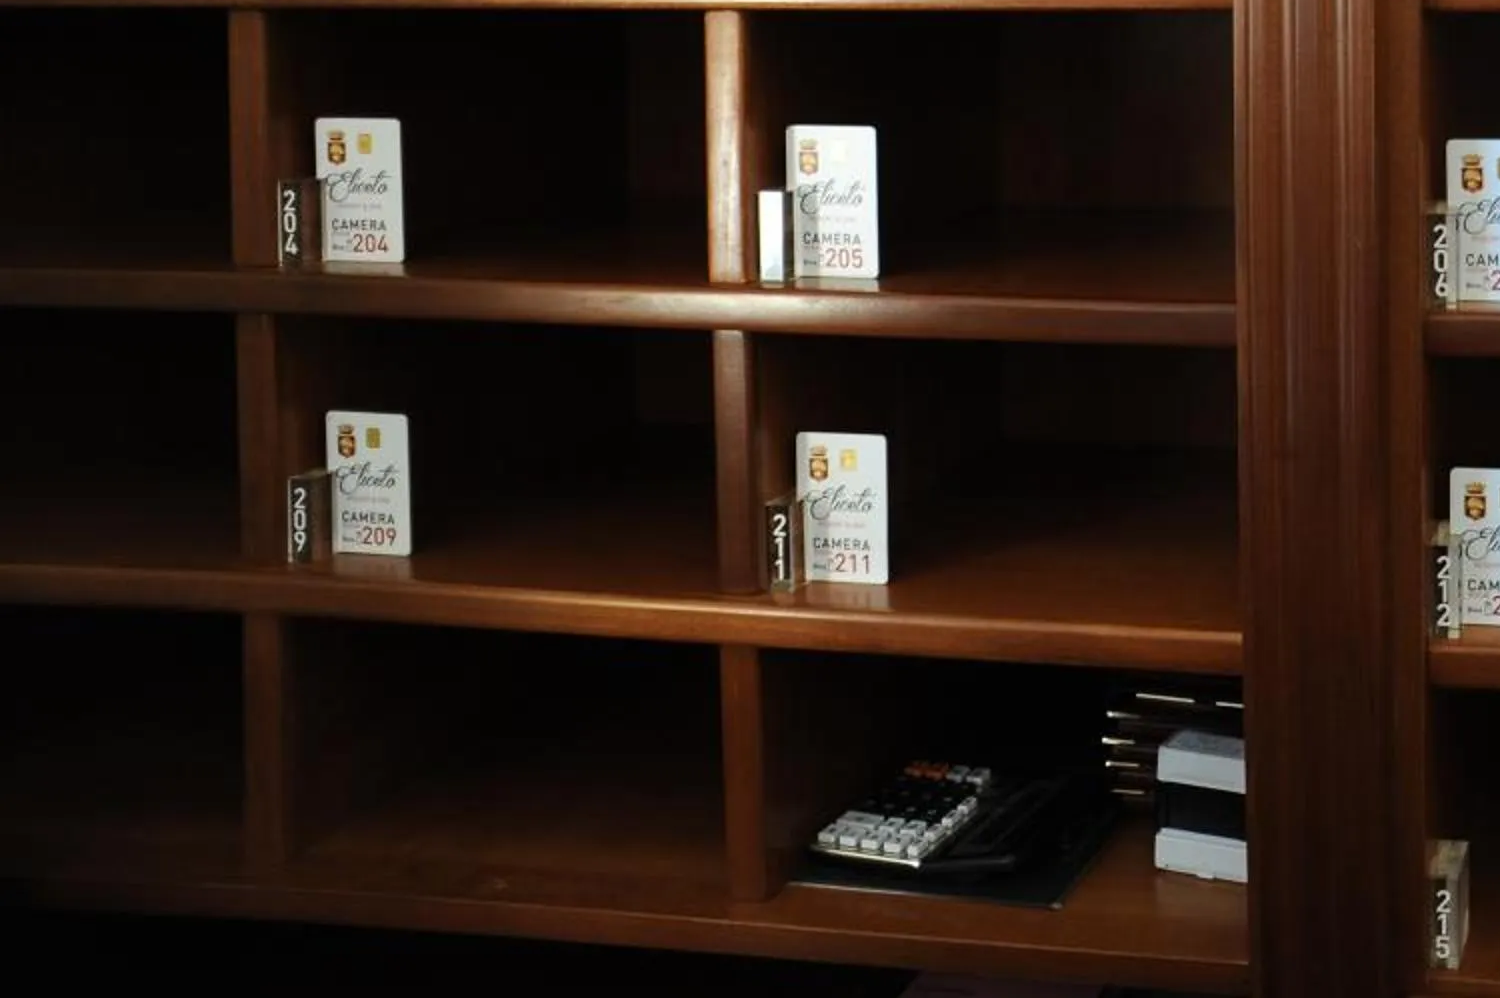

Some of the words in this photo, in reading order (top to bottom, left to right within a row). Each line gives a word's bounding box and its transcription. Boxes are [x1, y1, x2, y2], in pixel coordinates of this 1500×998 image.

[283, 190, 299, 255] 204
[331, 219, 388, 232] CAMERA
[353, 233, 390, 253] 204
[803, 233, 862, 245] CAMERA
[825, 248, 864, 268] 205
[1433, 225, 1448, 298] 206
[293, 487, 307, 553] 209
[342, 510, 395, 524] CAMERA
[361, 526, 397, 546] 209
[813, 537, 871, 551] CAMERA
[773, 513, 787, 582] 211
[835, 553, 871, 574] 211
[1436, 556, 1450, 627] 212
[1435, 890, 1451, 959] 215
